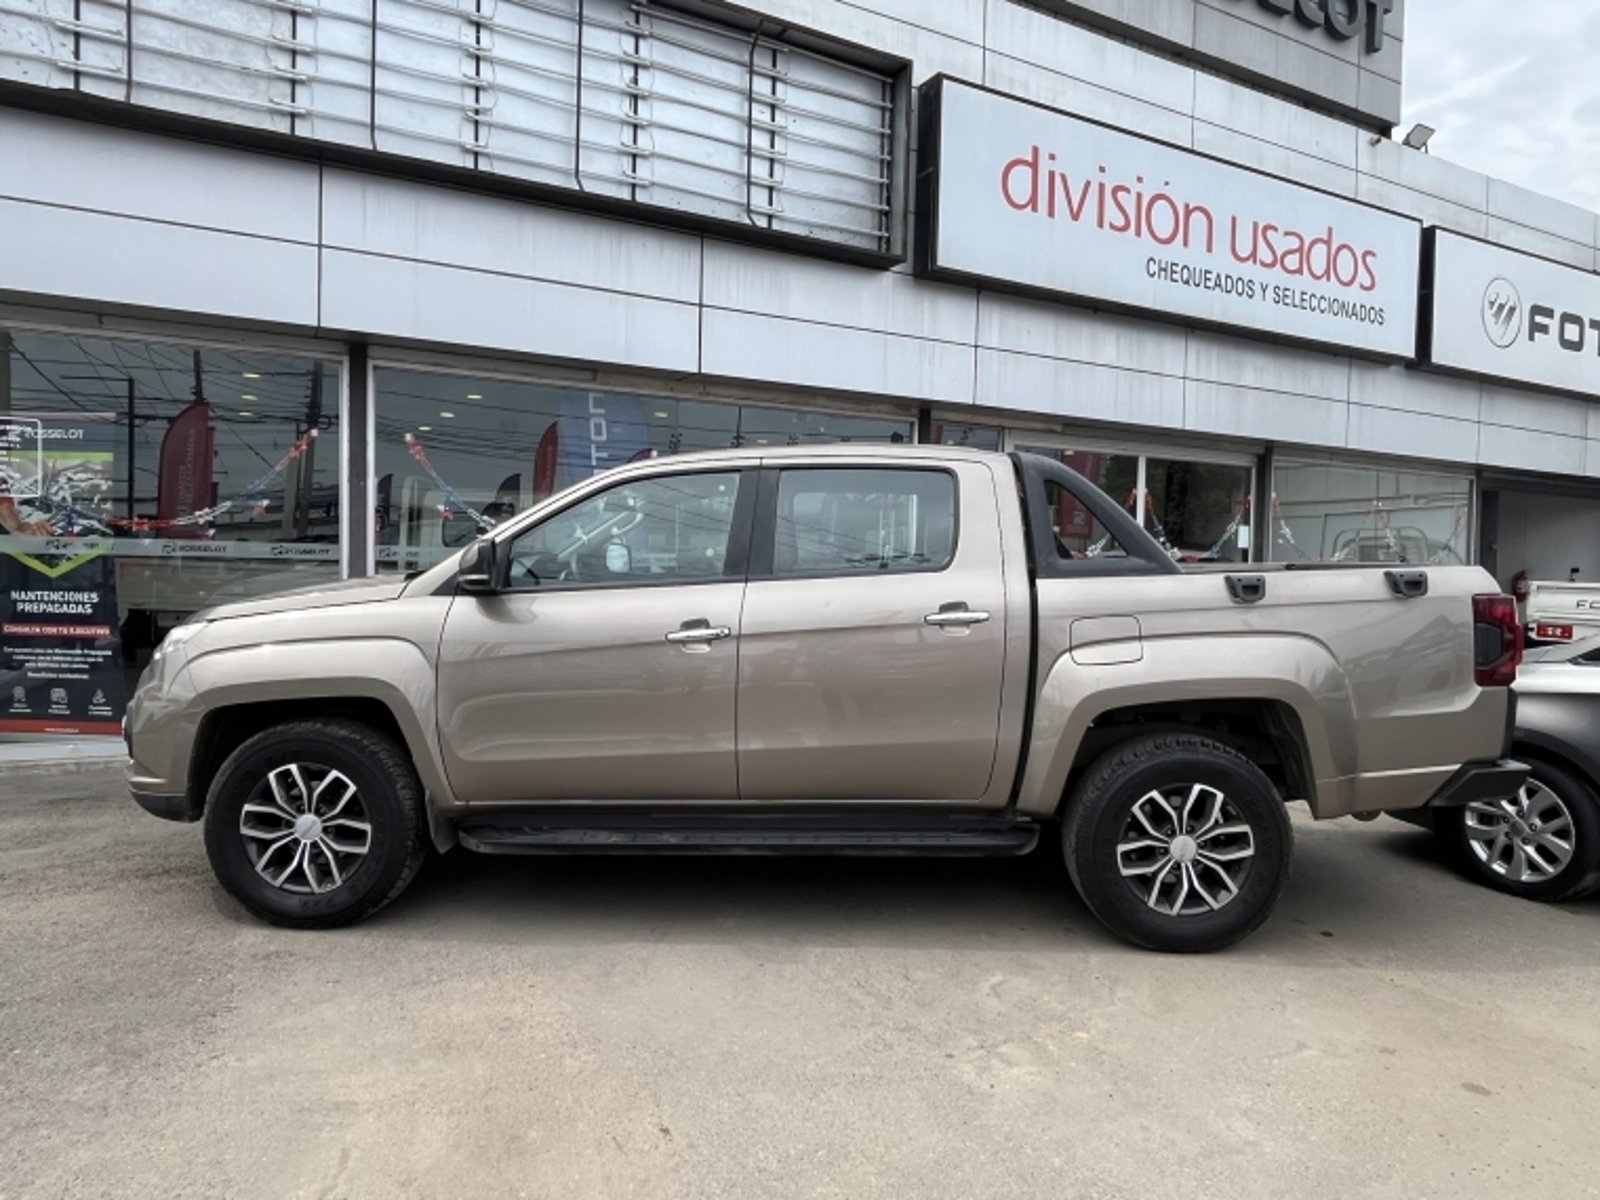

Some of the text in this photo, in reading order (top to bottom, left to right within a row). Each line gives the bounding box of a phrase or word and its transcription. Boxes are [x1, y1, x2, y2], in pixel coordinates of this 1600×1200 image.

[1000, 145, 1378, 292] división usados
[1146, 256, 1386, 326] CHEQUEADOS Y SELECCIONADOS
[10, 590, 100, 603] MANTENCIONES
[16, 602, 93, 615] PREPAGADAS
